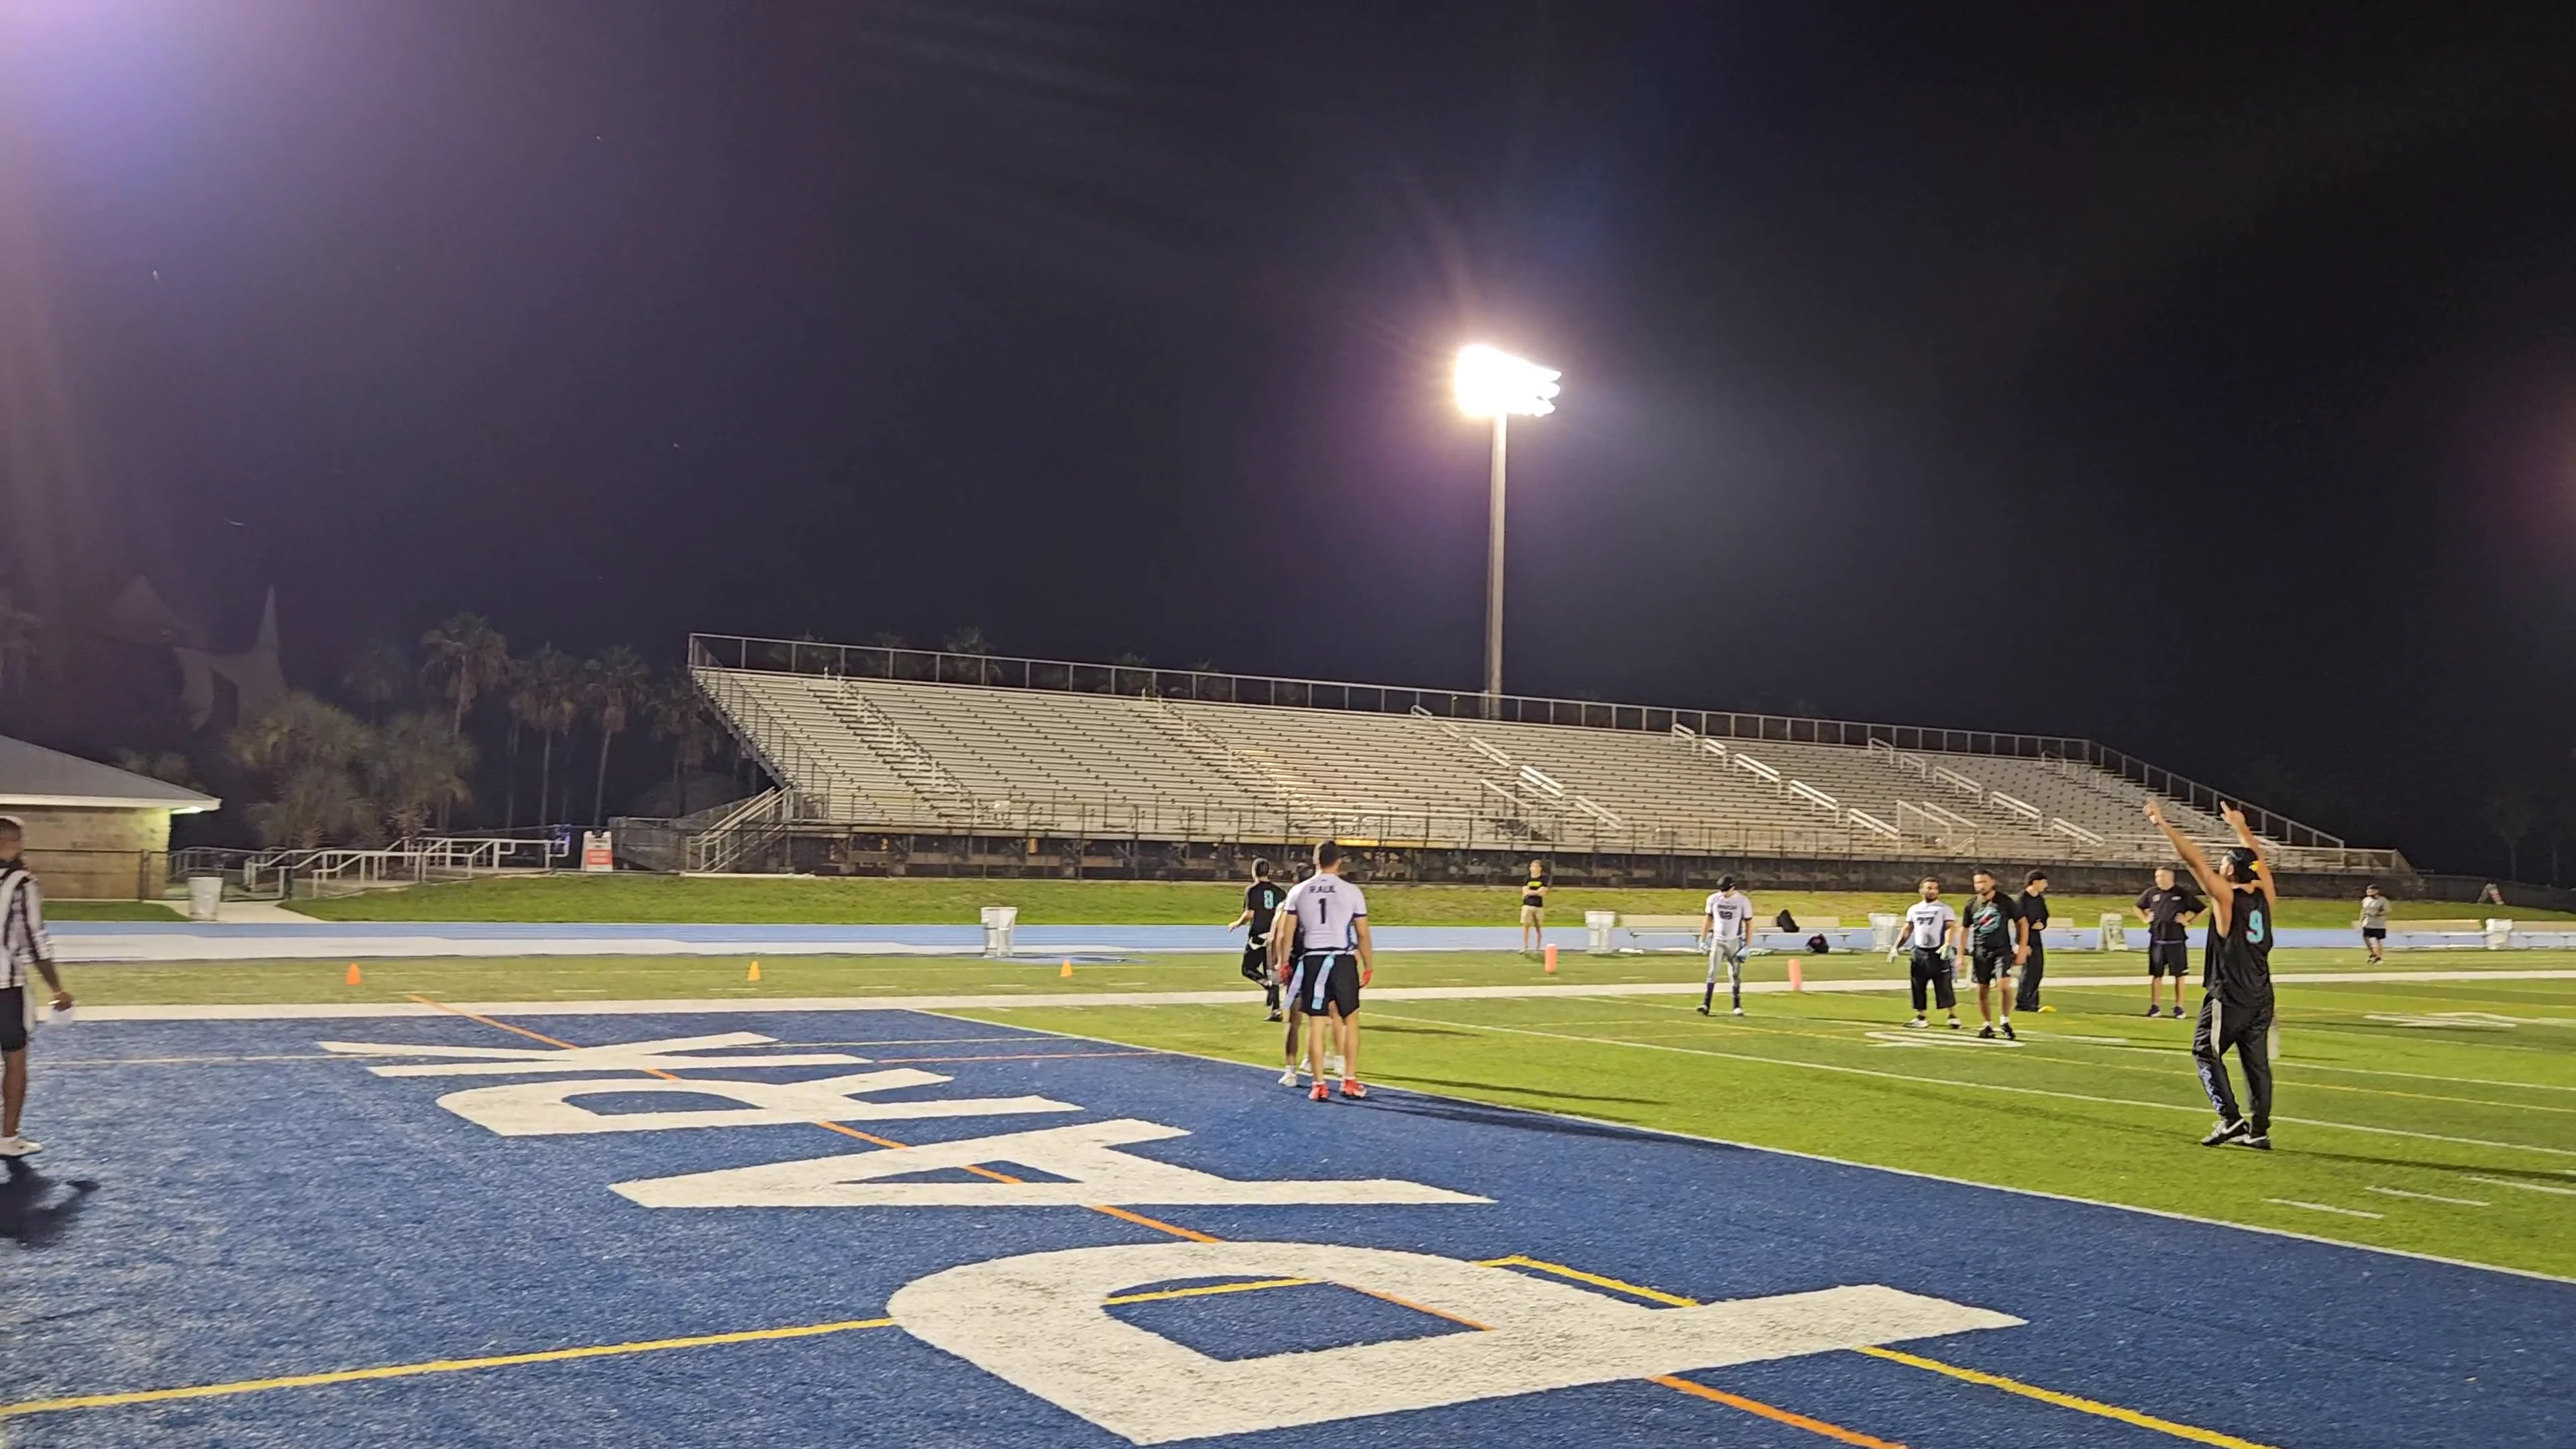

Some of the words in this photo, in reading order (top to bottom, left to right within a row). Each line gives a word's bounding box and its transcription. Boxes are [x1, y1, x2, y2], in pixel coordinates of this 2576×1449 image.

[1264, 890, 1274, 908] 8
[1318, 898, 1327, 924] 1
[2246, 910, 2264, 944] 9
[318, 1031, 2029, 1445] PARK
